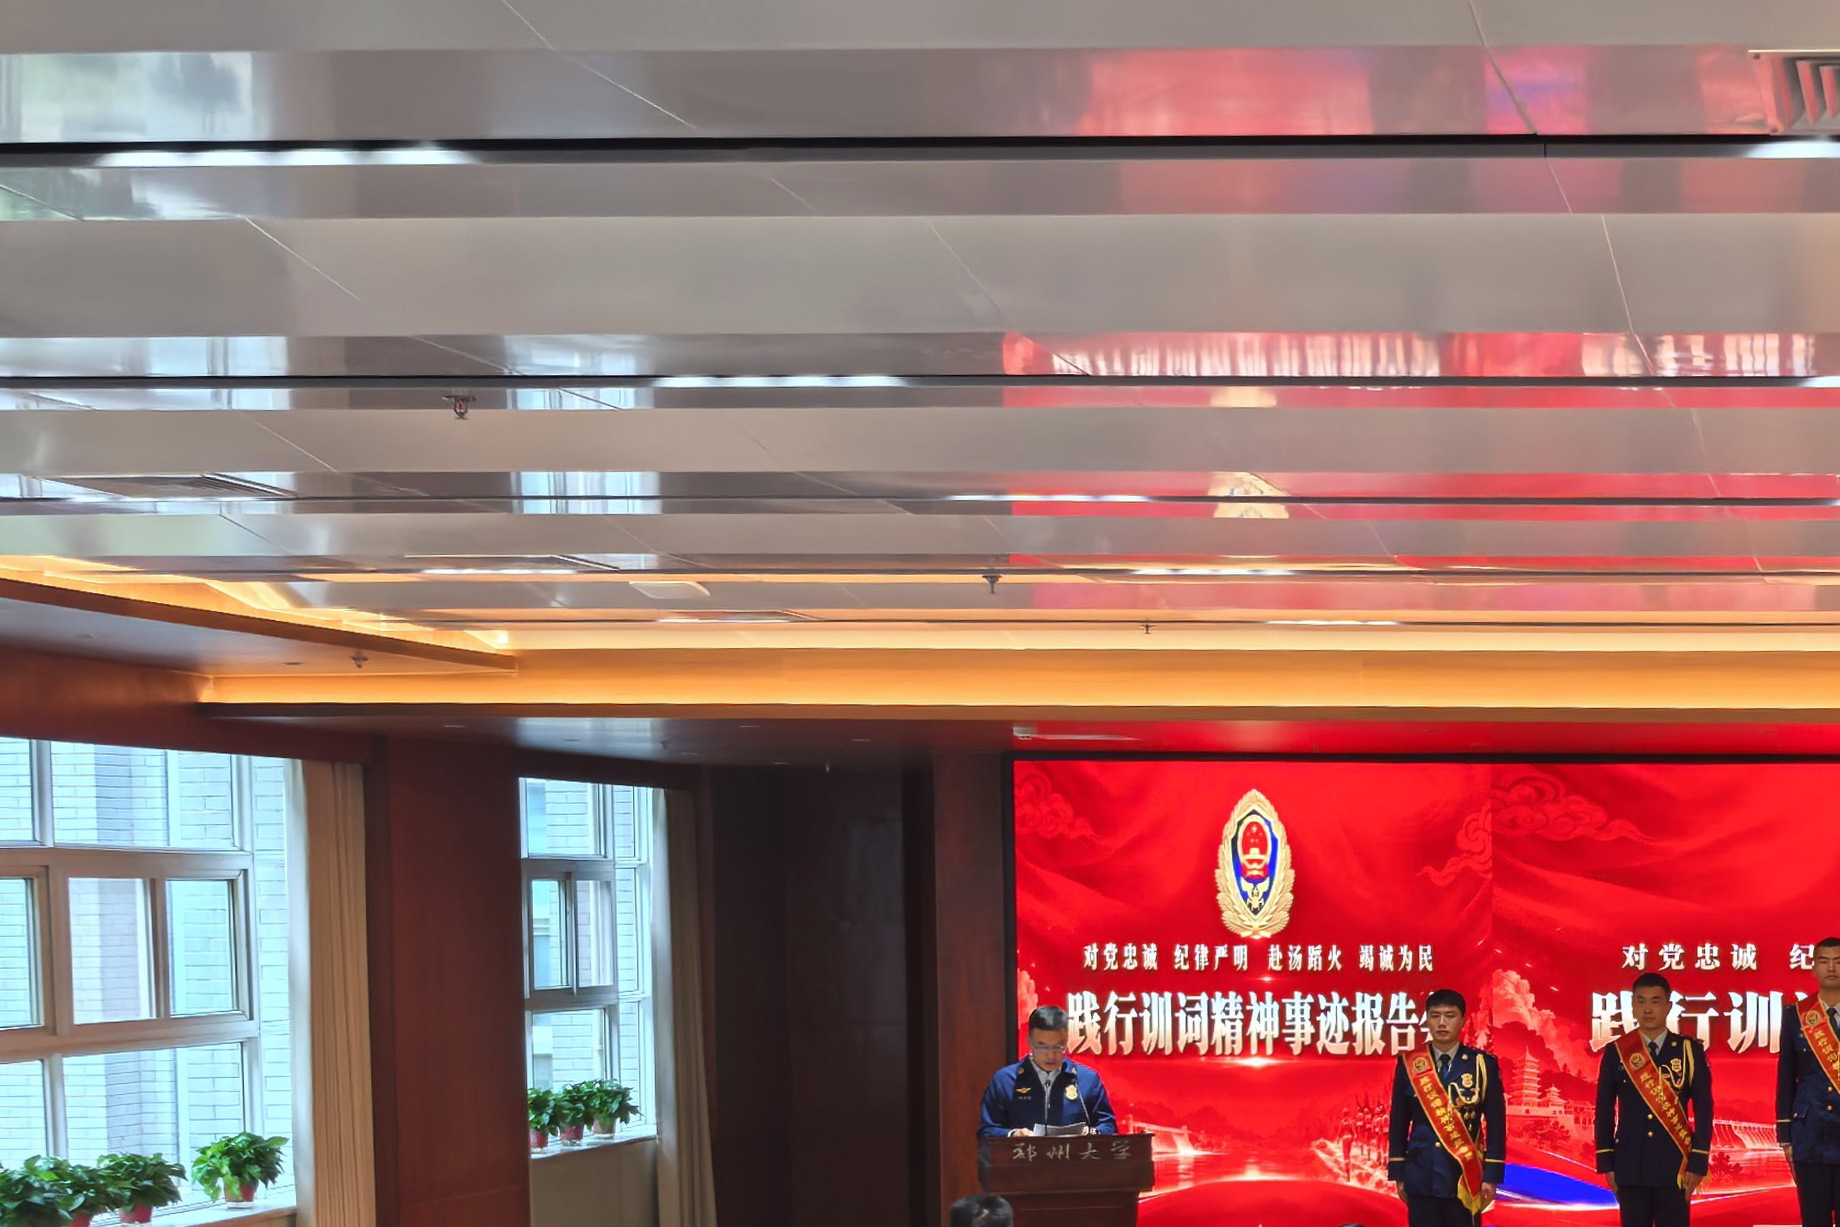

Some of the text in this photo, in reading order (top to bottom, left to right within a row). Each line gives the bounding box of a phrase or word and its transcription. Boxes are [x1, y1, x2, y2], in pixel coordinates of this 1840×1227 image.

[1084, 943, 1433, 971] 对党忠诚 纪律严明 赴汤蹈火 竭诚为民
[1622, 943, 1757, 971] 对党忠诚
[1066, 991, 1431, 1056] 践行训词精神事迹报告
